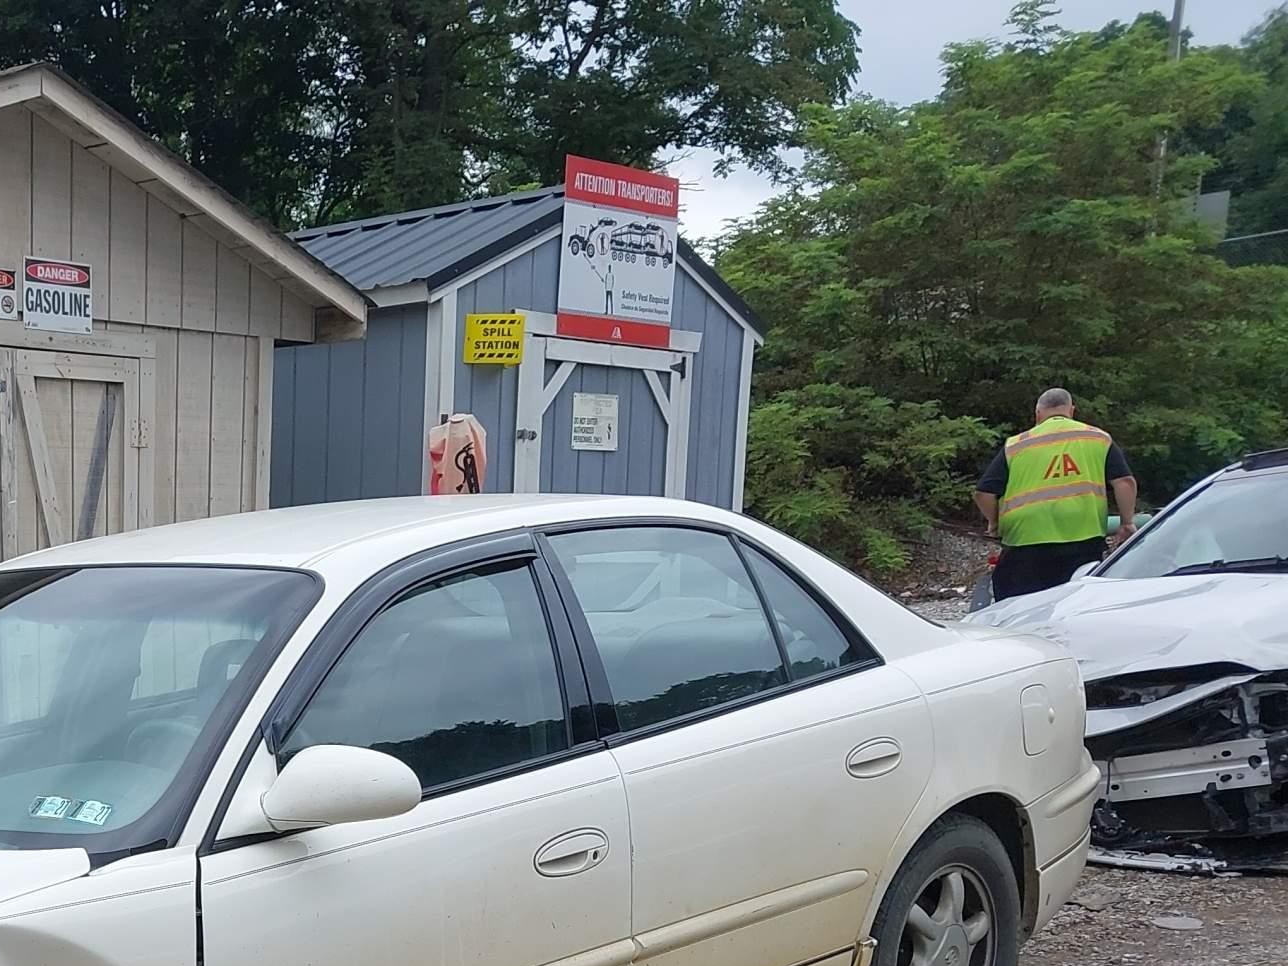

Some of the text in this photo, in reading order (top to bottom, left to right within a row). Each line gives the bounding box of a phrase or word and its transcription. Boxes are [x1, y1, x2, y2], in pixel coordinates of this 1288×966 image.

[574, 172, 674, 207] ATTENTION TRANSPORTERS!
[37, 266, 79, 281] DANGER
[25, 287, 91, 318] GASOLINE
[482, 327, 513, 337] SPILL
[474, 340, 520, 350] STATION
